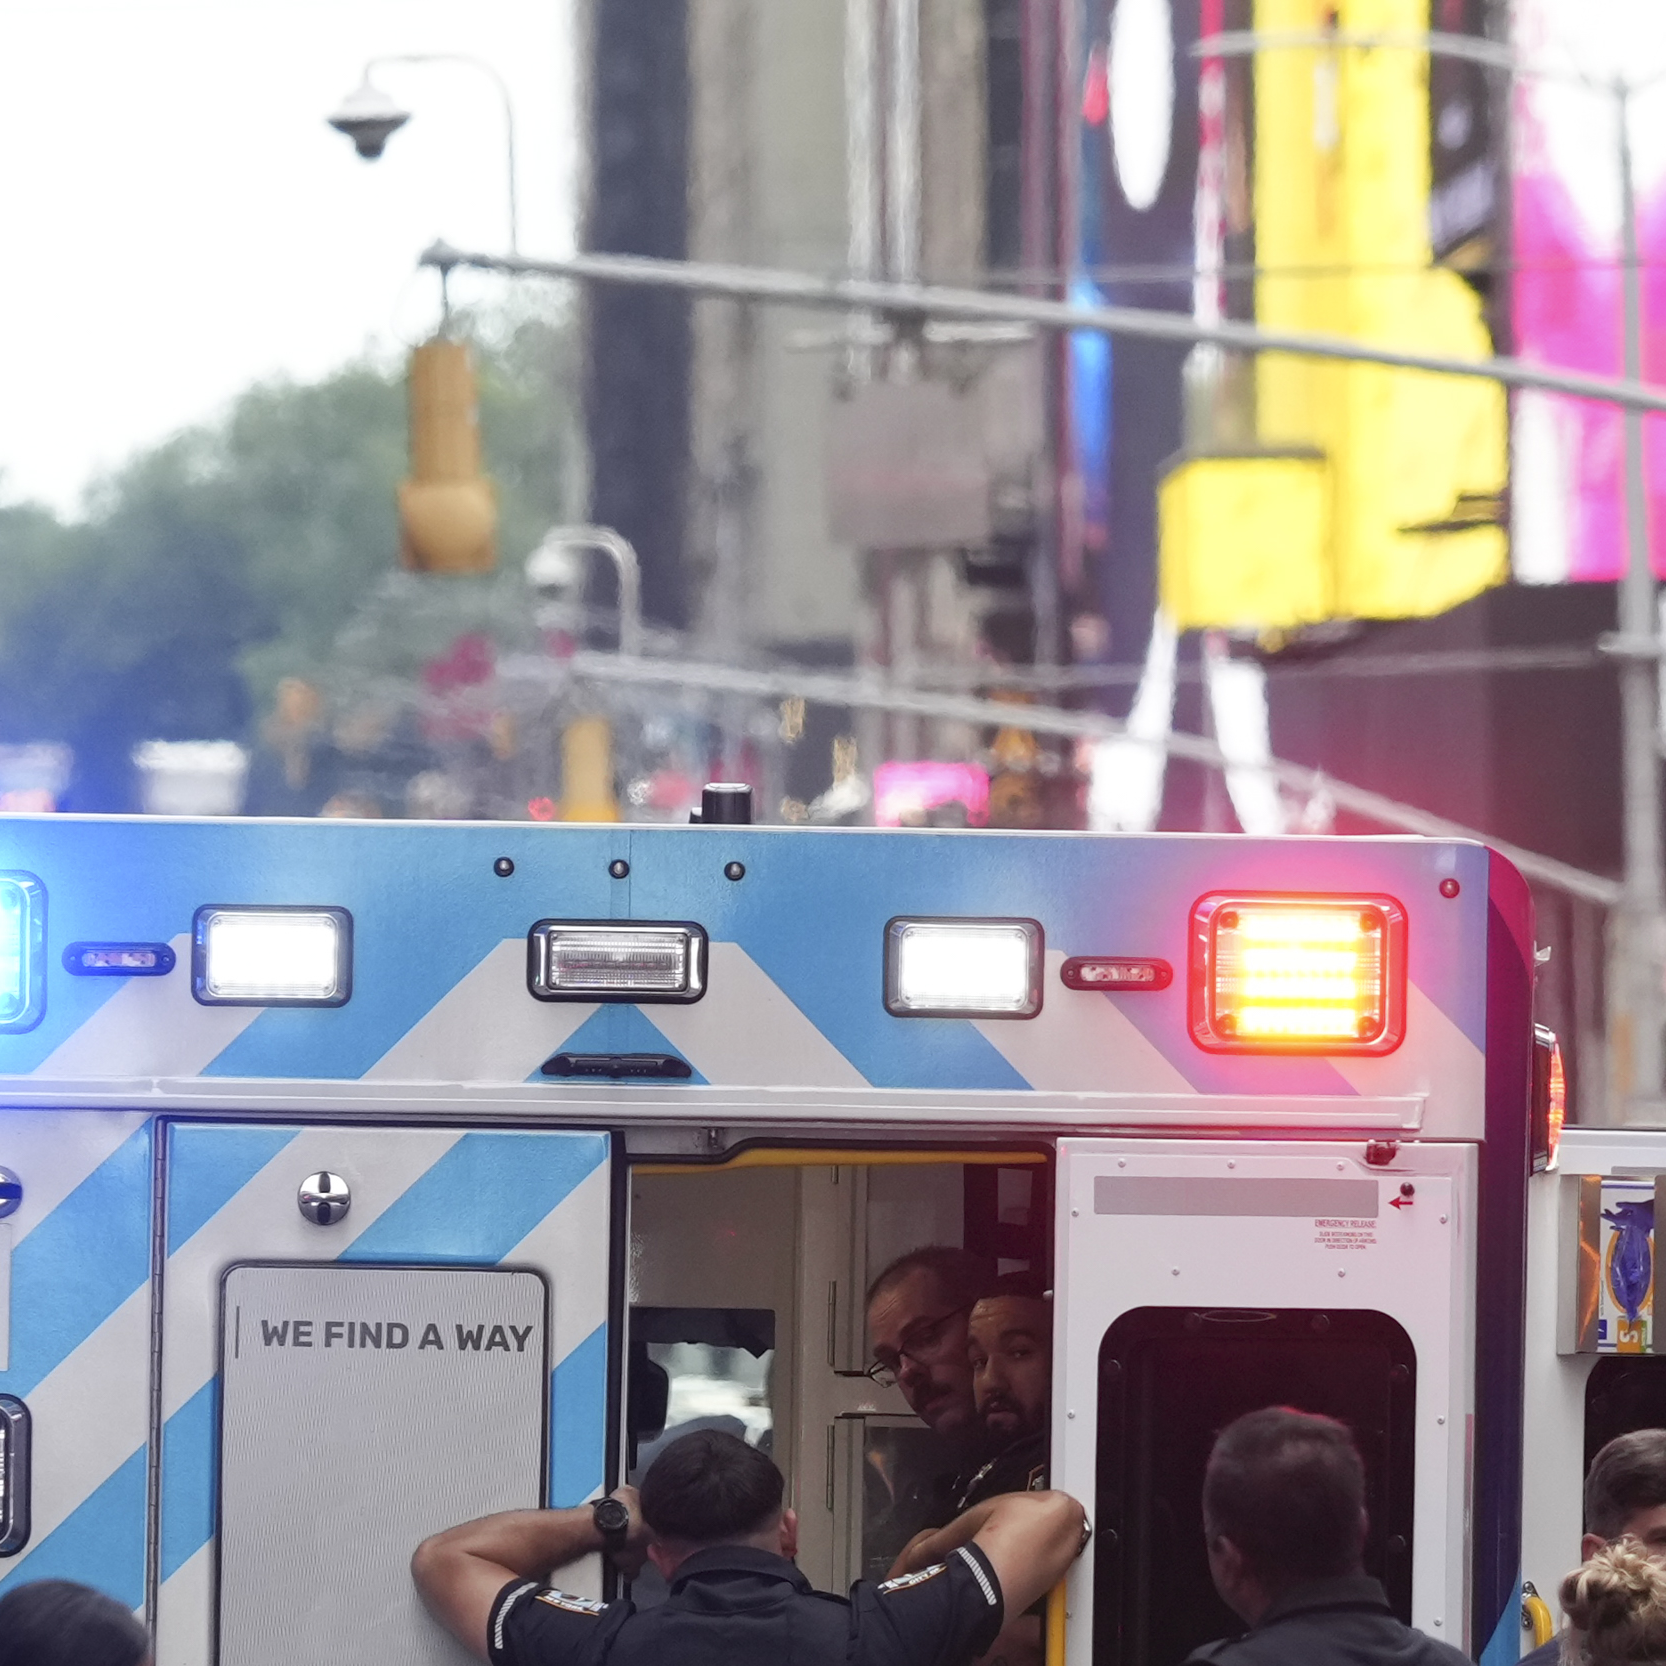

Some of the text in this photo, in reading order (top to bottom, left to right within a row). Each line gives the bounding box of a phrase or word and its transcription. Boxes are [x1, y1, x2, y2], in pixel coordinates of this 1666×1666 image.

[261, 1319, 534, 1352] WE FIND A WAY
